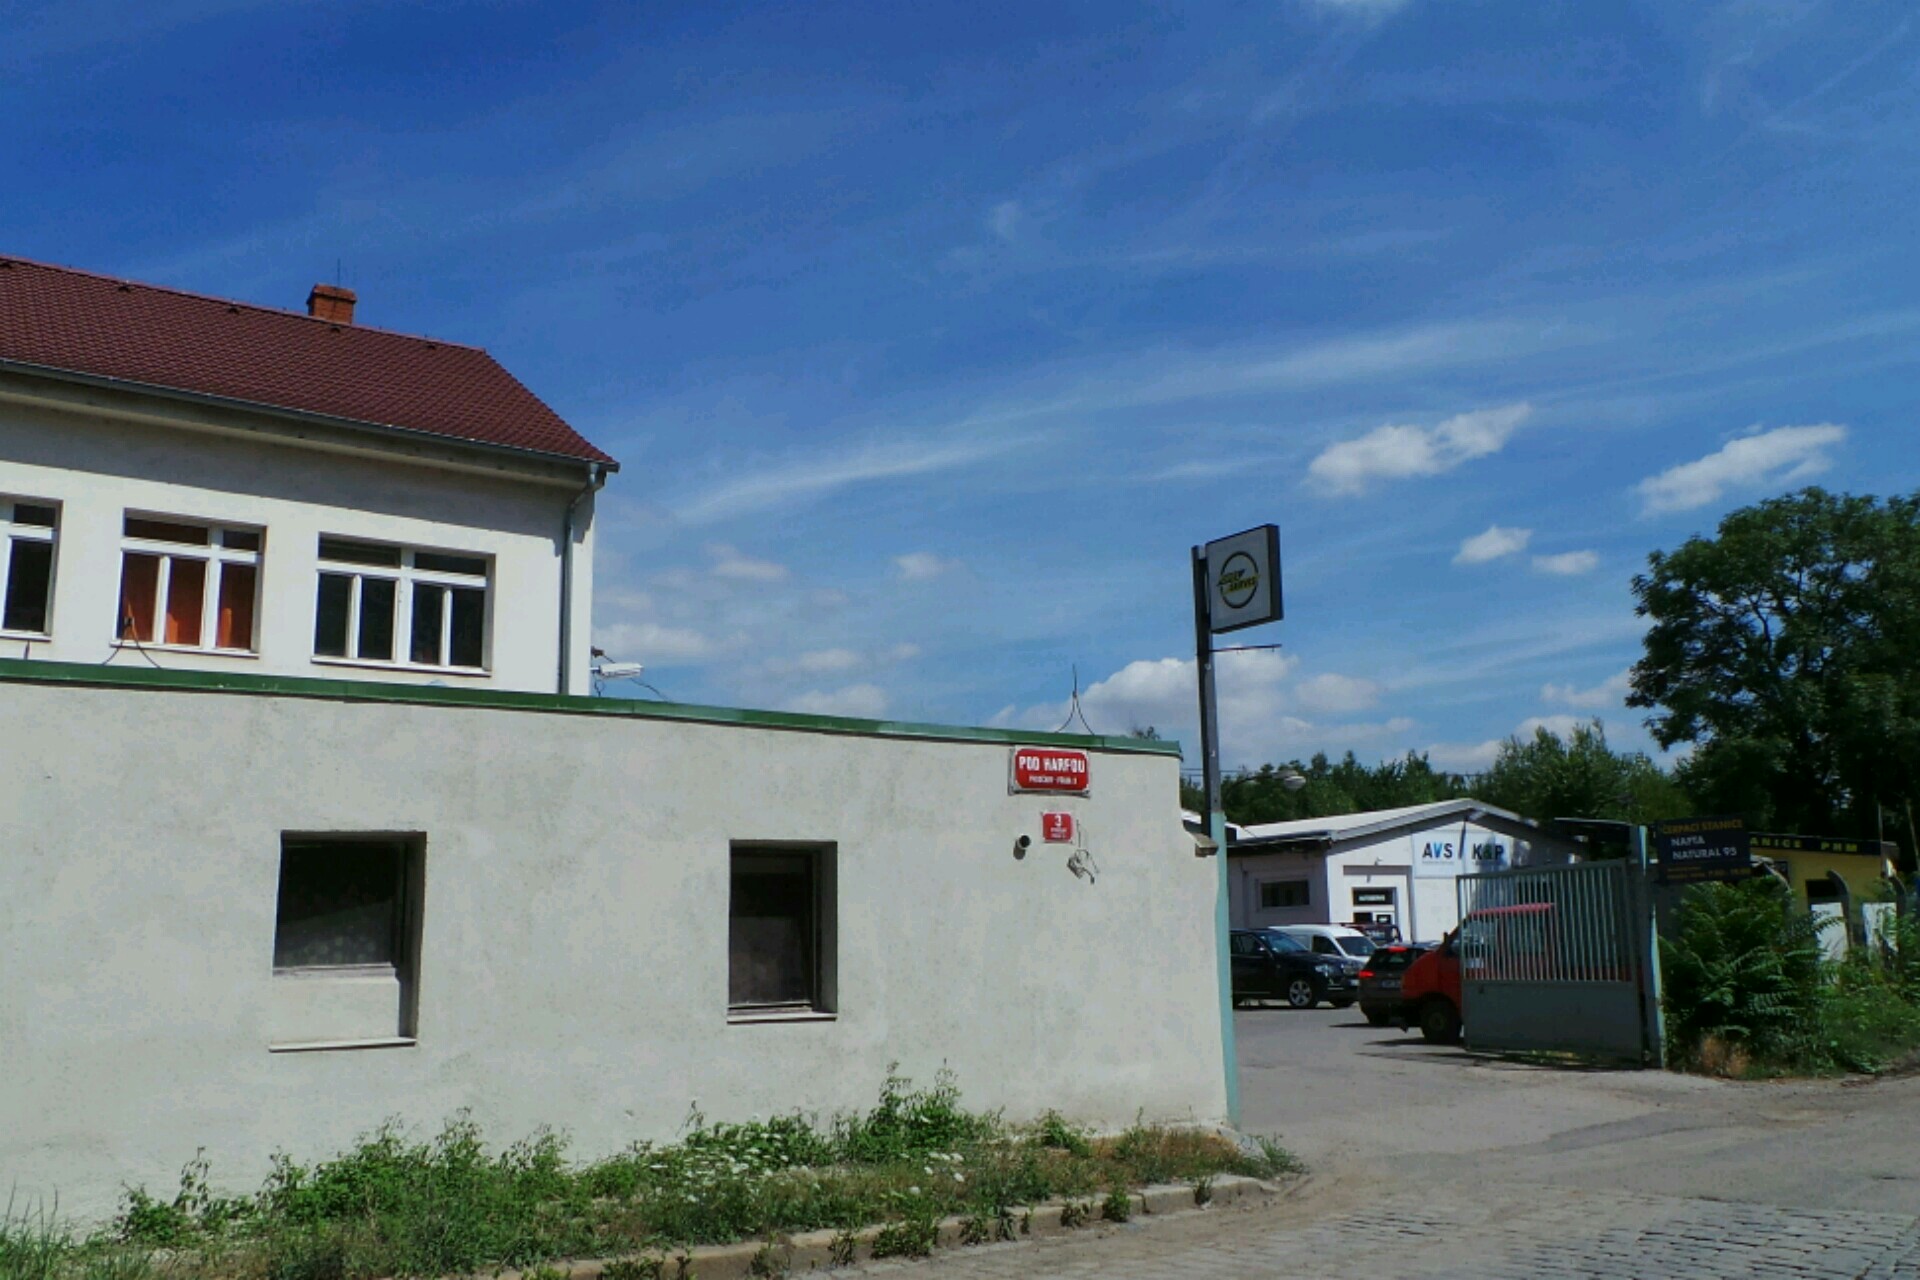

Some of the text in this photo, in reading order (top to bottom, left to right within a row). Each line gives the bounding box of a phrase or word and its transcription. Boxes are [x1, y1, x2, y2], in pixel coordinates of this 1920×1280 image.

[1018, 756, 1086, 773] POD HARFOU
[1055, 815, 1062, 827] 3
[1422, 842, 1454, 859] AVS
[1672, 847, 1722, 860] NATURAL
